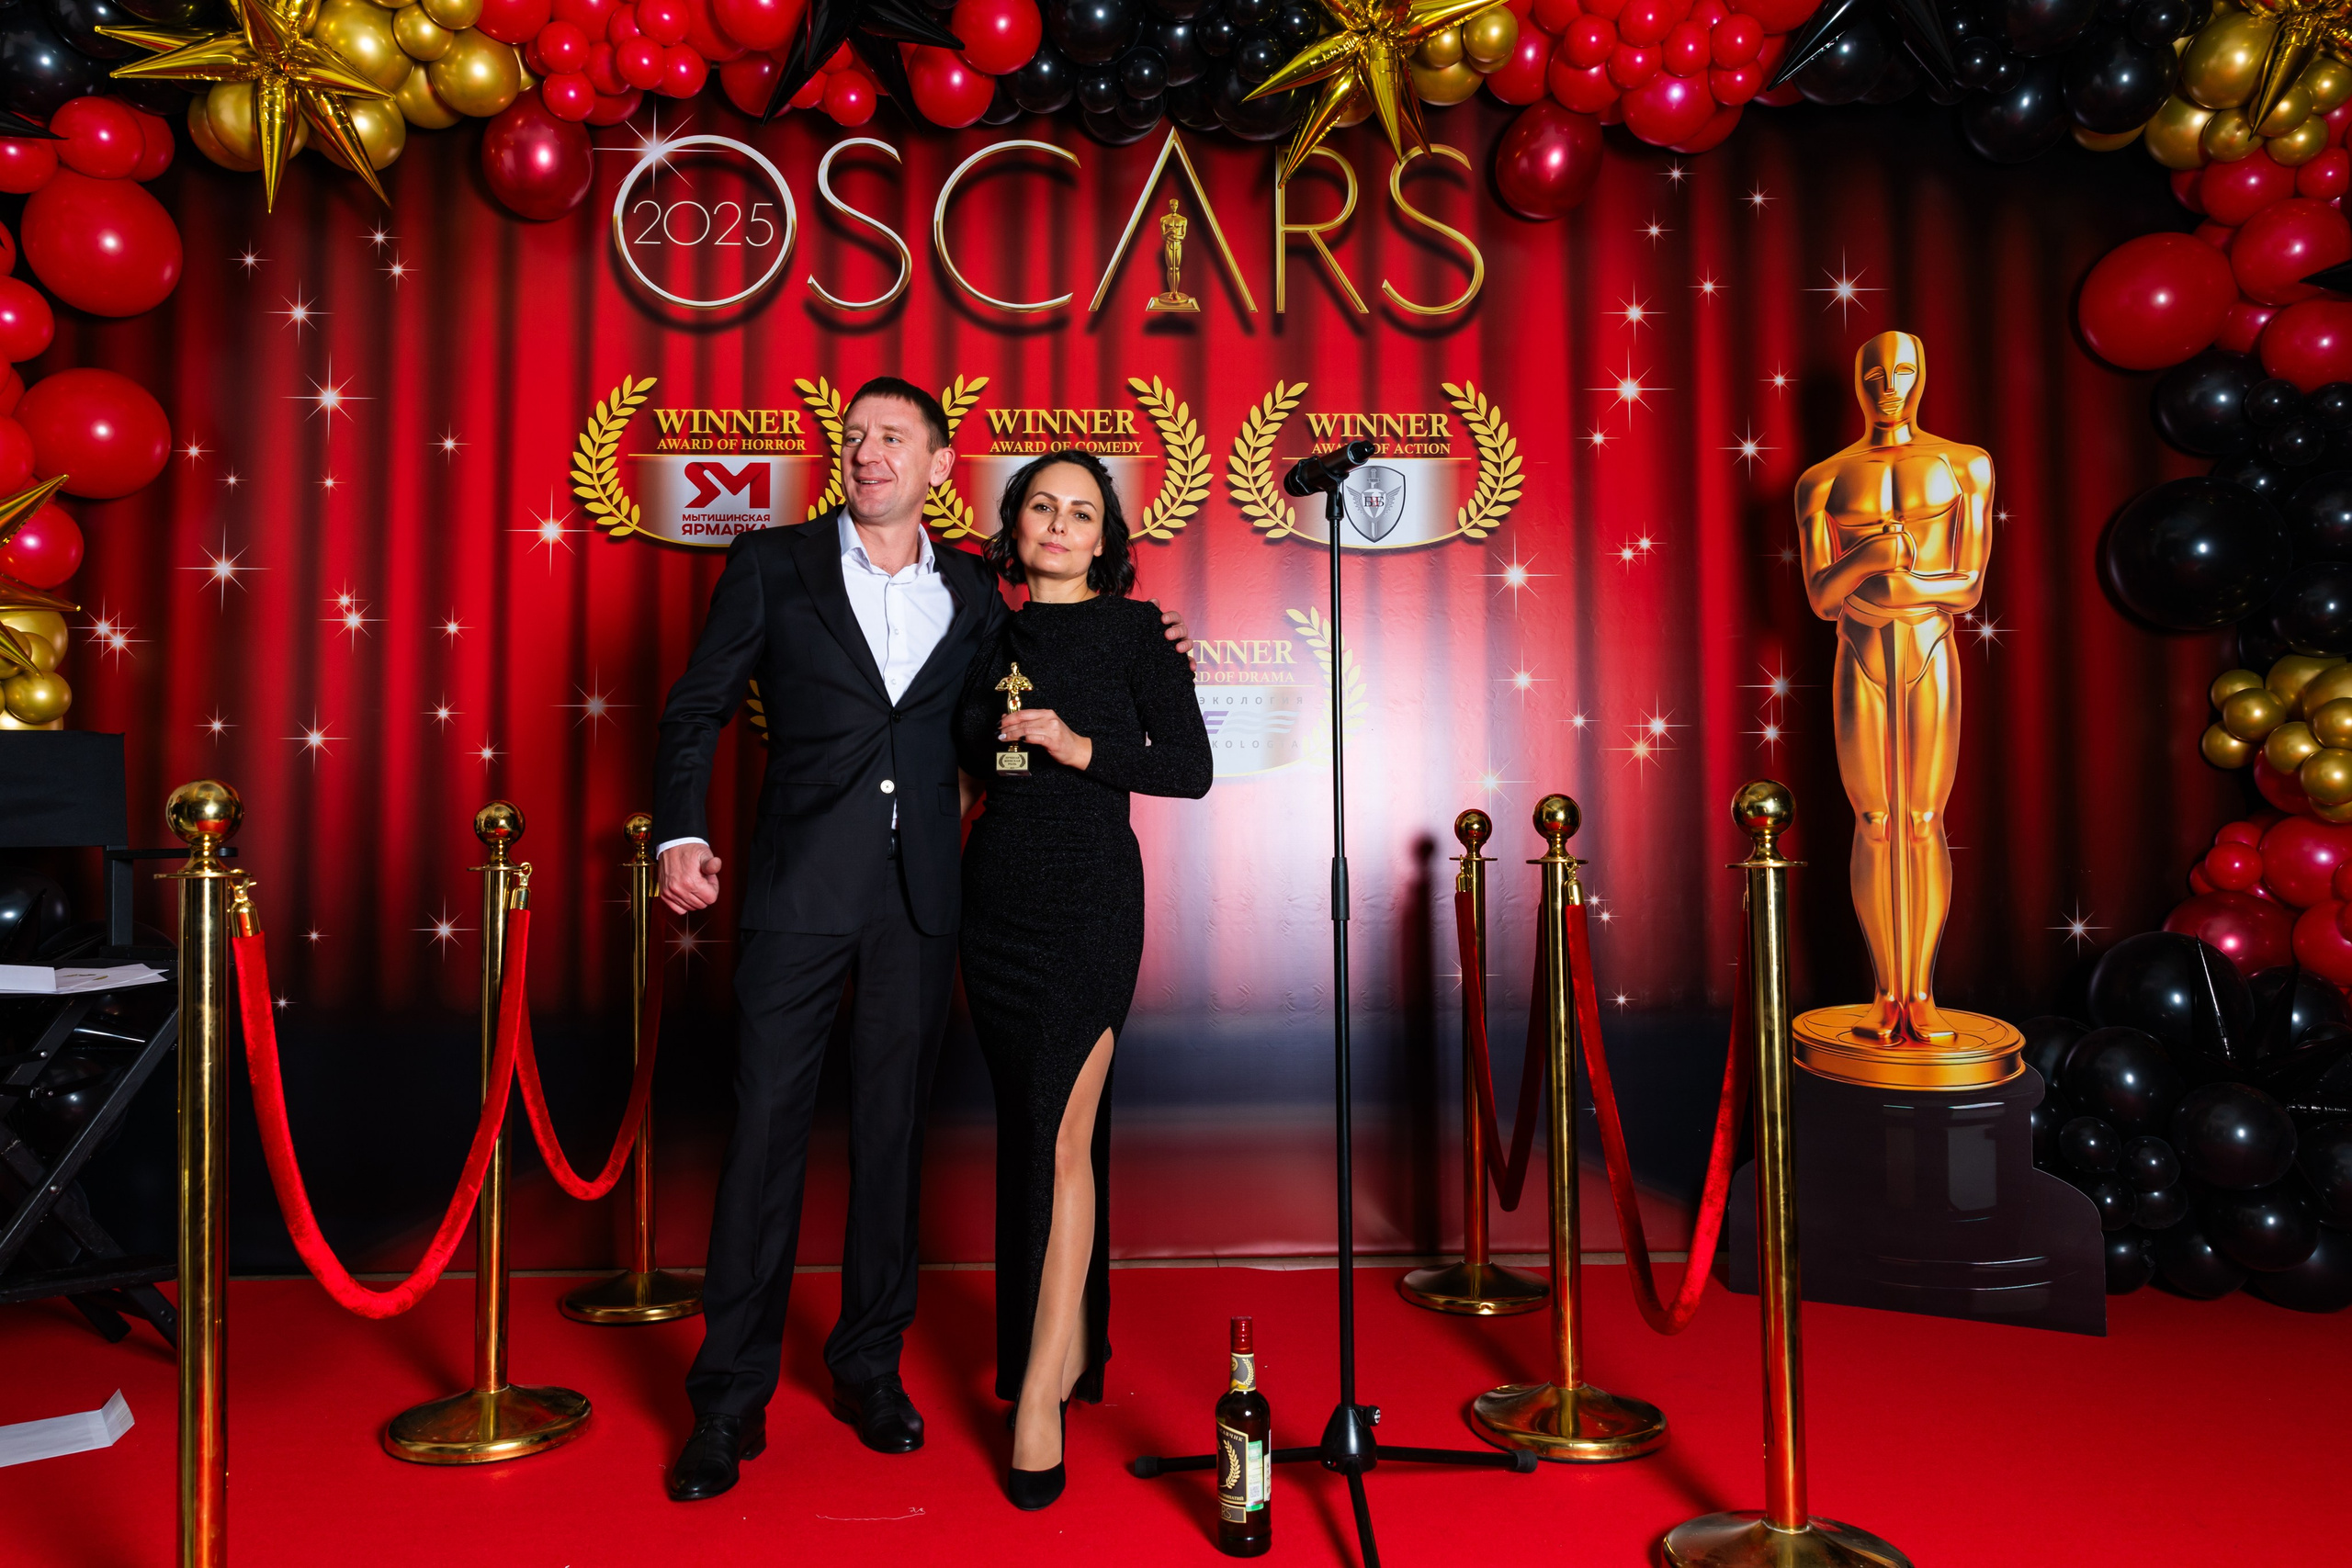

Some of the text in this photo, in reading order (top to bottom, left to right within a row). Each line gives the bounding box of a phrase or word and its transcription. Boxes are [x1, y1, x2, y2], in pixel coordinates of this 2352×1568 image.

[613, 126, 1485, 314] OSCARS
[634, 200, 774, 247] 2025
[653, 409, 806, 434] WINNER
[986, 409, 1140, 434] WINNER
[1306, 413, 1453, 437] WINNER
[656, 438, 807, 451] AWARD OF HORROR
[989, 441, 1144, 453] AWARD OF COMEDY
[1395, 443, 1452, 455] ACTION
[682, 513, 771, 523] МЫТИЩИНСКАЯ
[1187, 639, 1297, 665] NNER
[1215, 671, 1236, 683] OF
[1238, 671, 1295, 683] DRAMA
[1212, 739, 1299, 749] KOLOGIA
